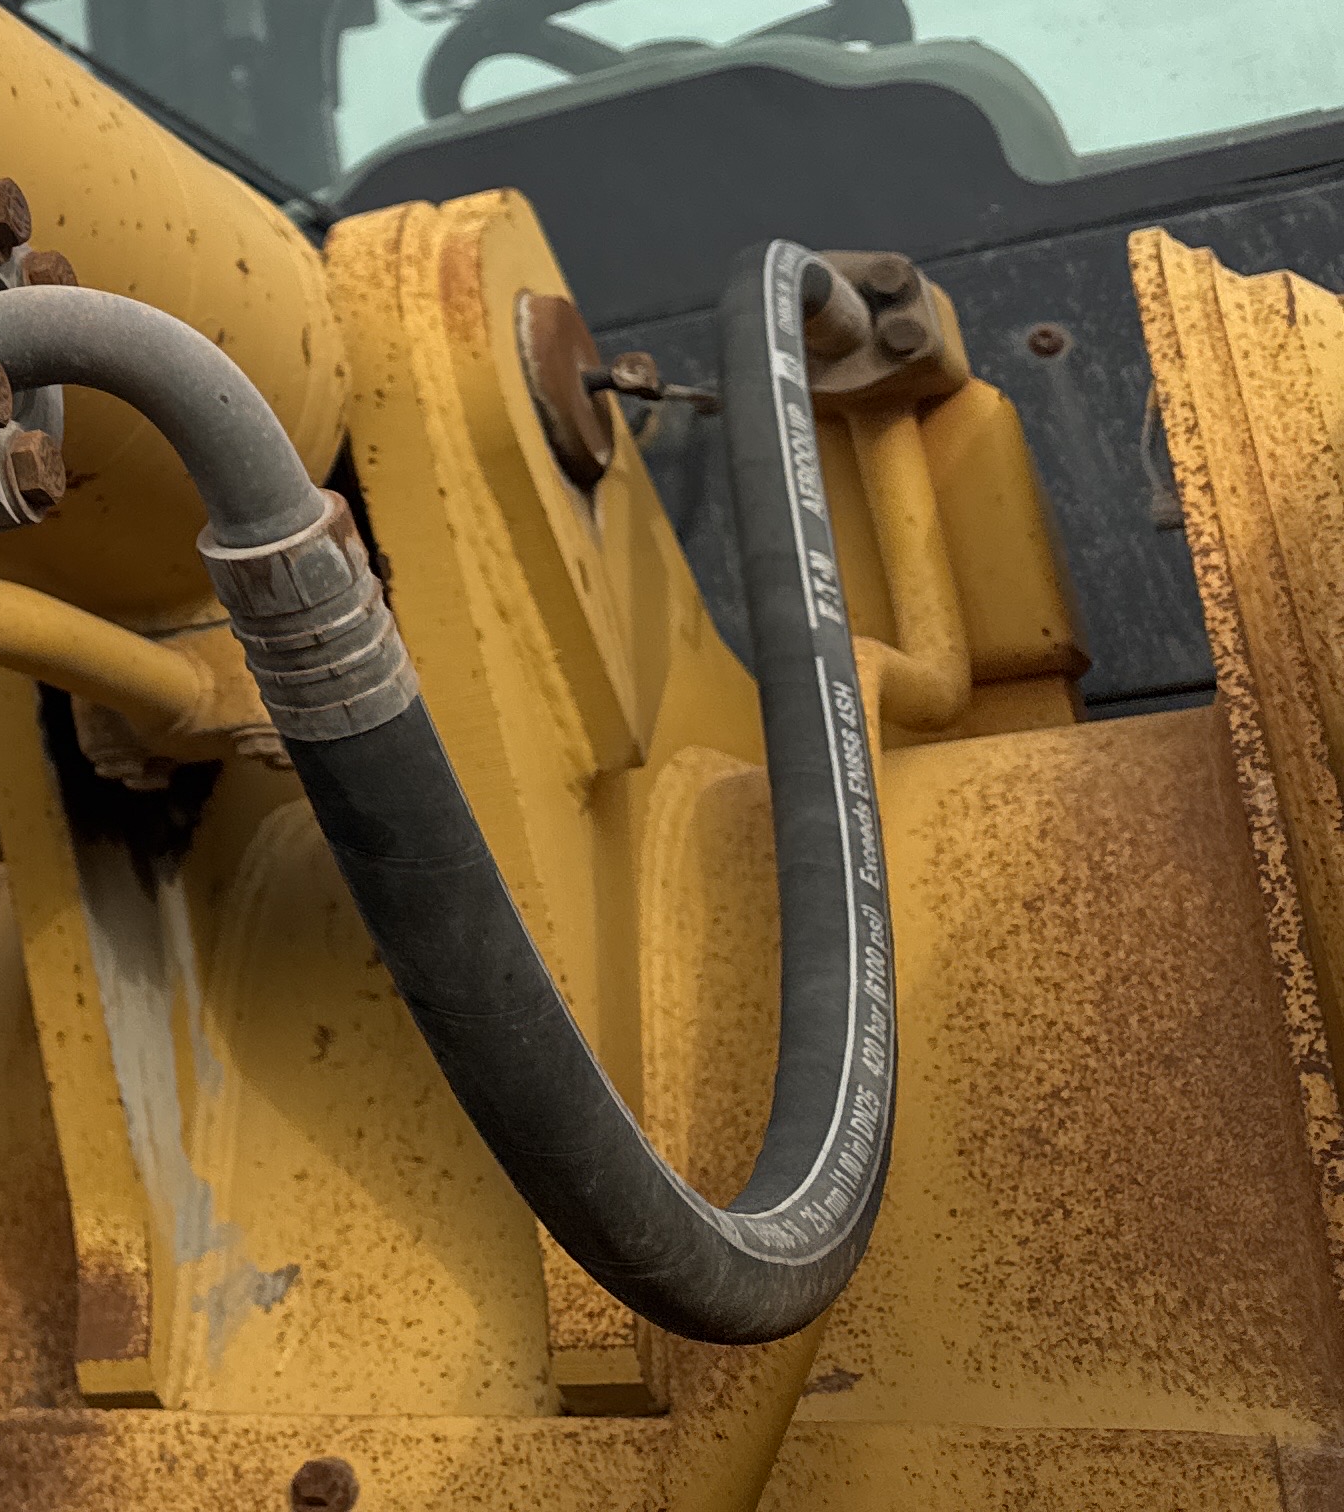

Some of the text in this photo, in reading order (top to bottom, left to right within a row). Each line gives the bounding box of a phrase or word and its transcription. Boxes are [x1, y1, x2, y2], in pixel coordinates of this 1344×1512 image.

[785, 402, 824, 522] AEROQUIP
[852, 800, 881, 891] Exceeds
[861, 904, 886, 951] psi)
[863, 945, 887, 1007] (6100
[863, 1004, 886, 1041] bar
[861, 1037, 885, 1078] 420
[847, 1084, 880, 1139] DN25
